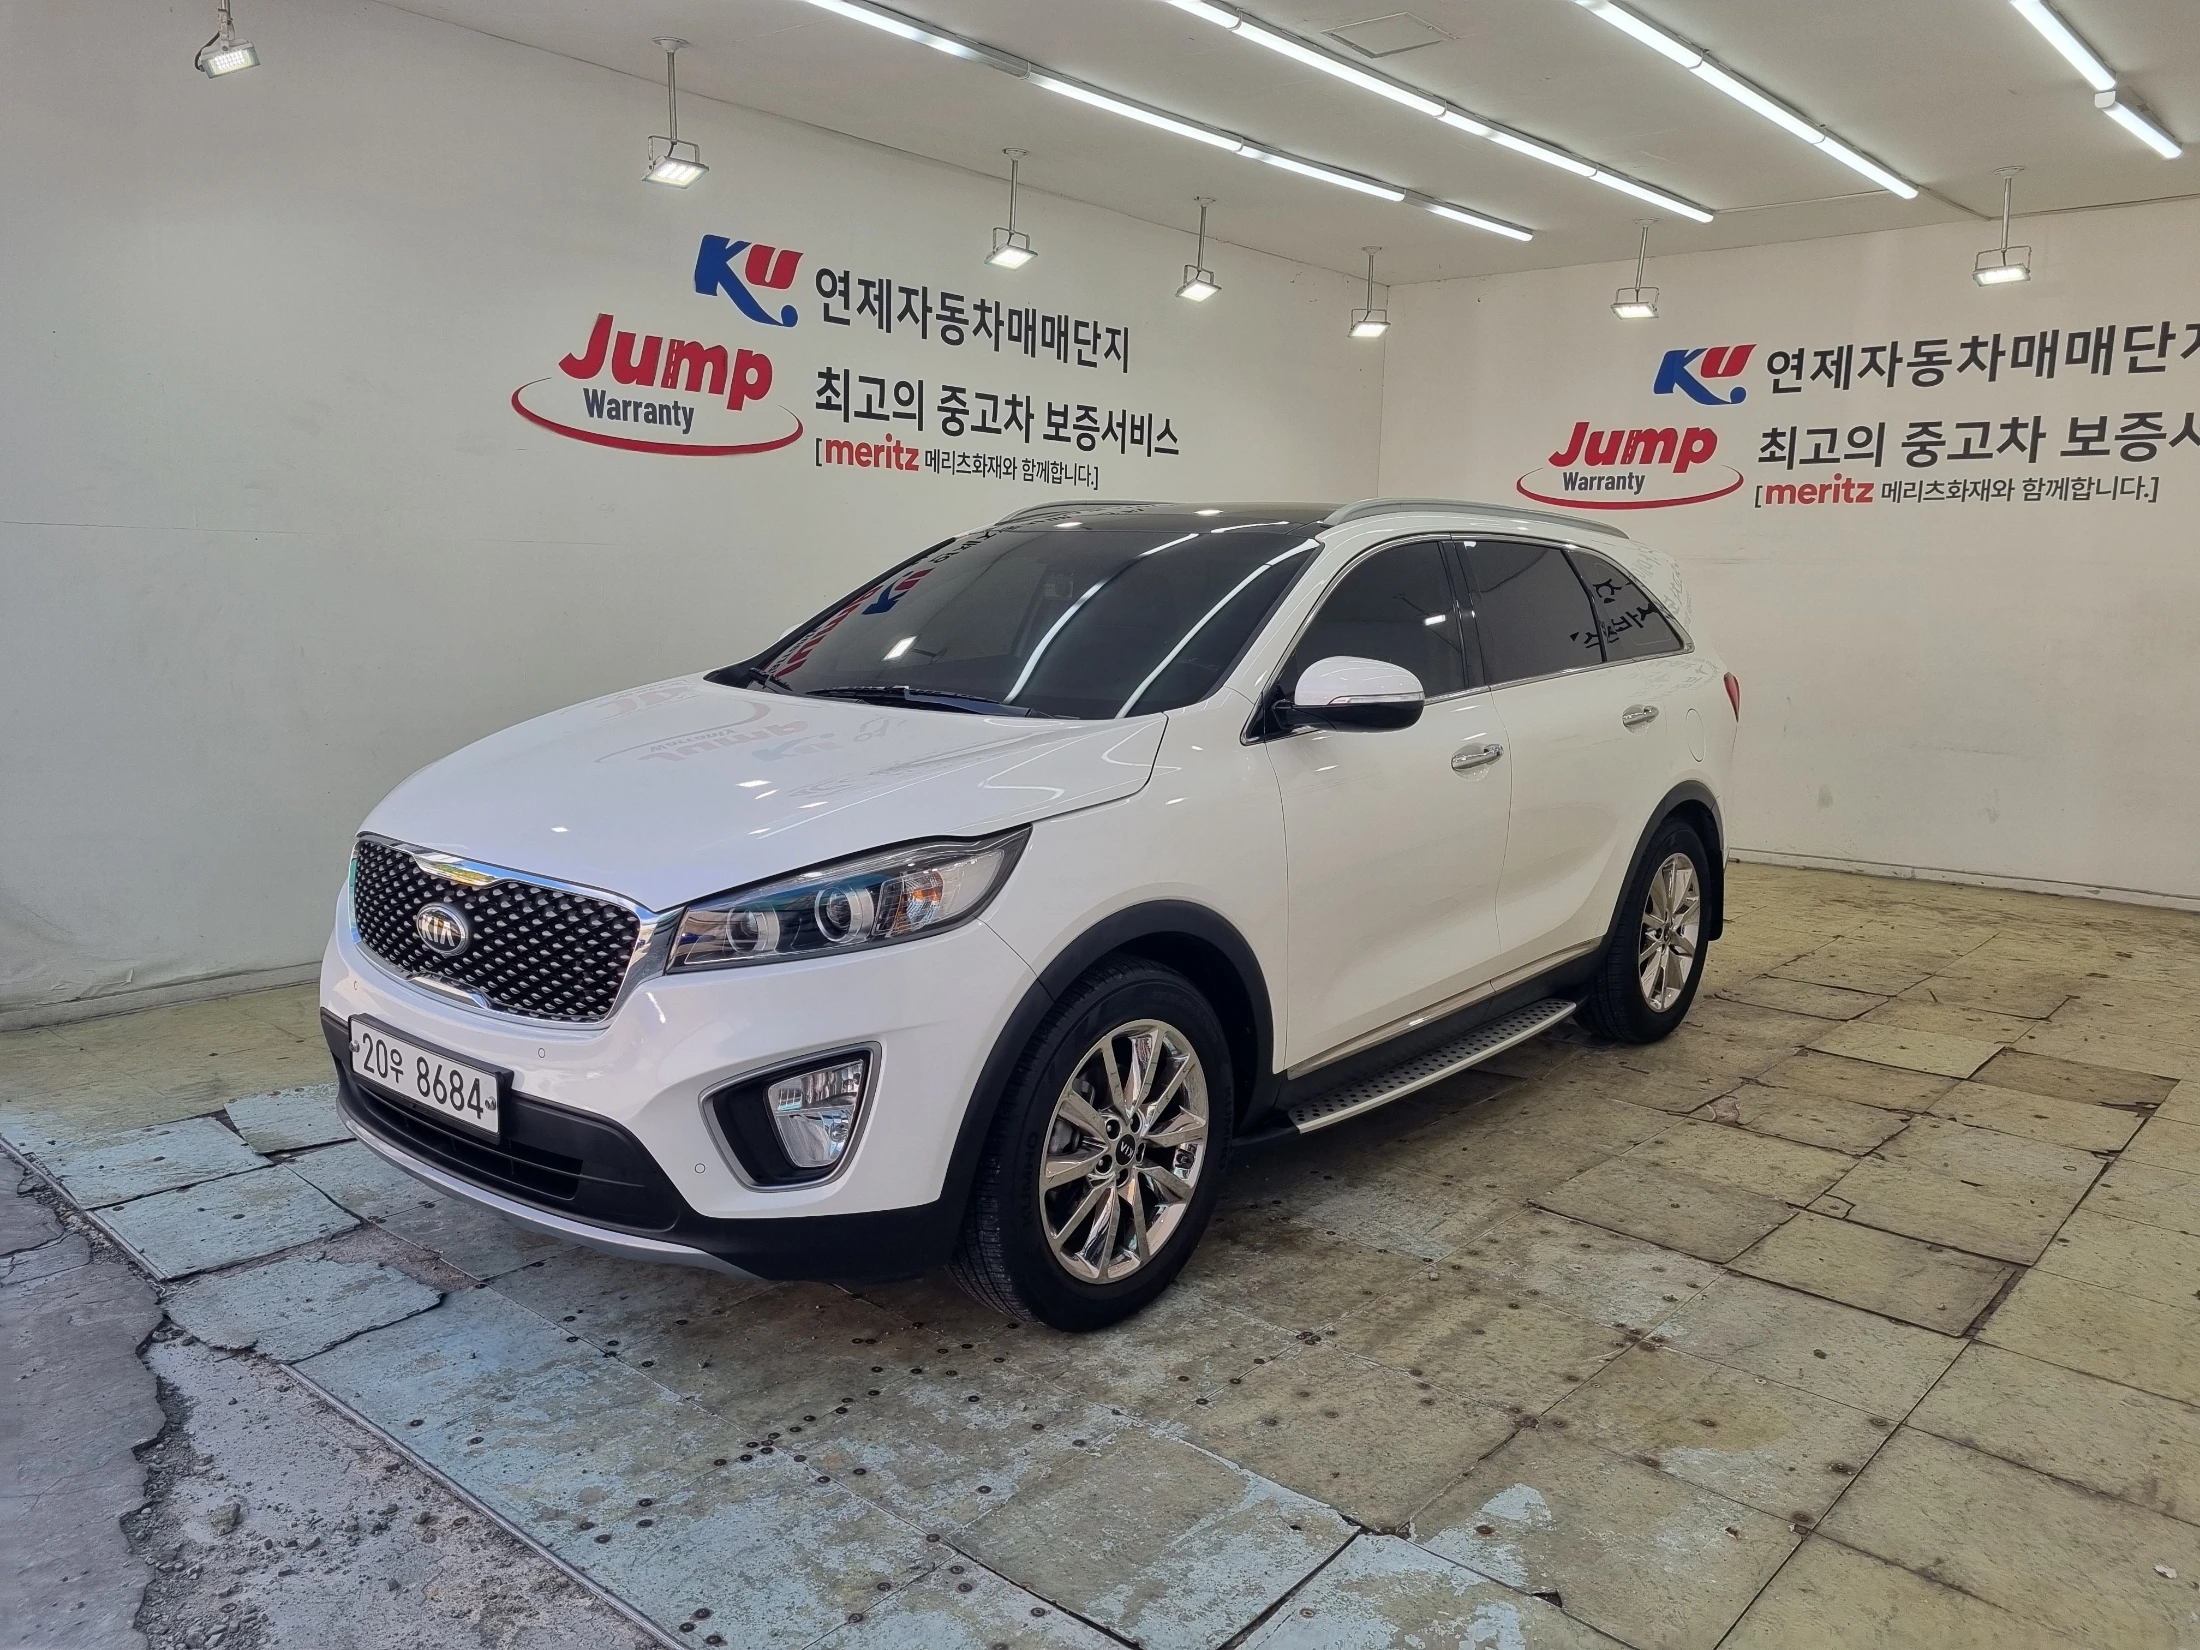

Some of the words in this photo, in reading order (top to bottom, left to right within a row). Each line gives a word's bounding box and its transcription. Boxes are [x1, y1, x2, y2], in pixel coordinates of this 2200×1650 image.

[815, 267, 1129, 374] 연제자동차매매단지
[558, 314, 773, 411] Jump
[582, 387, 695, 435] Warranty
[815, 366, 924, 437] 최고의
[936, 384, 1035, 444] 중고차
[1042, 401, 1180, 458] 보증서비스
[924, 448, 1018, 481] 메리츠화재와
[1548, 421, 1718, 475] Jump
[1757, 421, 1886, 471] 최고의
[1901, 415, 2047, 468] 중고차
[1562, 471, 1646, 496] Warranty
[1881, 477, 2016, 504] 메리츠화재와
[422, 914, 456, 947] KIA
[362, 1032, 404, 1084] 20우
[416, 1056, 484, 1120] 8684
[1120, 1141, 1133, 1158] KIA
